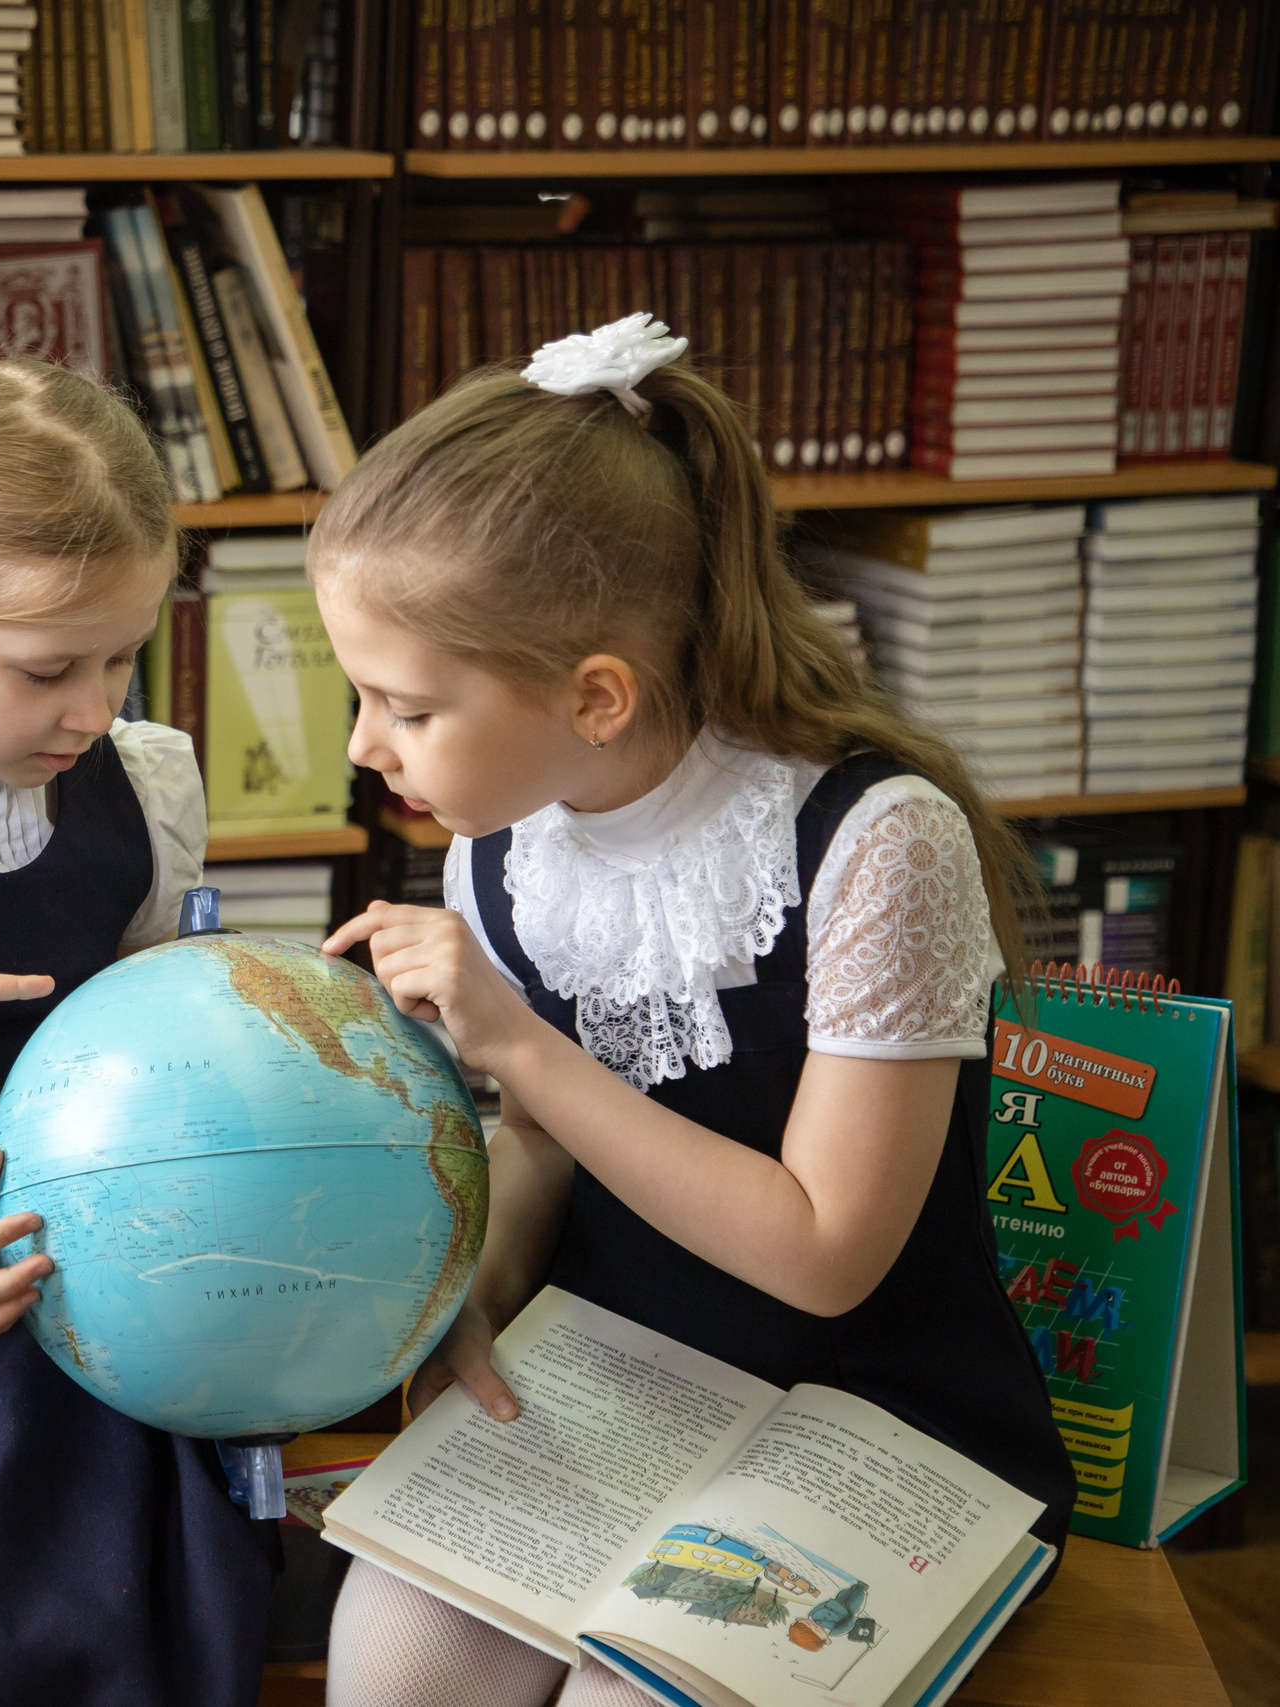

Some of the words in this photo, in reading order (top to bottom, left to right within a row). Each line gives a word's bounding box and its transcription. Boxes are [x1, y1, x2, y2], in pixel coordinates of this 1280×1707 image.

[994, 1026, 1048, 1077] 10
[1051, 1050, 1147, 1090] магнитных
[131, 1060, 210, 1077] ОКЕАН
[1046, 1065, 1085, 1089] букв
[1085, 1149, 1104, 1177] Лучшее
[1104, 1142, 1138, 1155] учебное
[1137, 1153, 1153, 1187] пособие
[1114, 1161, 1127, 1170] от
[1100, 1171, 1138, 1184] автора
[1089, 1180, 1146, 1197] «Букваря»
[205, 1285, 264, 1301] ТИХИЙ
[278, 1280, 336, 1294] ОКЕАН
[999, 1254, 1124, 1332] АЕМ
[799, 1413, 824, 1423] такой
[1068, 1409, 1083, 1418] при
[1085, 1412, 1115, 1423] письме
[795, 1431, 812, 1440] мне
[807, 1429, 846, 1449] какой-то
[814, 1438, 833, 1449] чего
[838, 1426, 875, 1447] ответили
[771, 1439, 800, 1450] совсем
[1075, 1438, 1111, 1451] навыков
[787, 1450, 824, 1467] хотелось
[802, 1448, 845, 1470] поставили
[835, 1448, 858, 1461] из-за
[783, 1463, 808, 1477] Всего
[791, 1457, 834, 1479] наверное,
[826, 1466, 842, 1477] как
[861, 1453, 894, 1475] двойку.
[861, 1460, 894, 1482] сказать,
[903, 1462, 919, 1473] что
[771, 1474, 795, 1486] было
[811, 1474, 845, 1495] двойку.
[845, 1476, 861, 1488] так,
[847, 1468, 877, 1490] двойку
[895, 1464, 931, 1488] природе.
[915, 1459, 971, 1497] учительницы:
[1083, 1471, 1108, 1482] цвета
[760, 1477, 800, 1495] началось,
[794, 1474, 837, 1498] вызывали.
[796, 1484, 812, 1494] нас
[835, 1478, 868, 1501] двойки,
[895, 1481, 929, 1505] смешно
[896, 1473, 945, 1506] несчастную
[920, 1472, 967, 1505] Интересно,
[803, 1494, 817, 1504] это
[827, 1498, 847, 1512] утра.
[839, 1497, 861, 1512] меня
[846, 1492, 882, 1517] получил
[878, 1487, 905, 1506] пятую
[942, 1493, 963, 1509] воды
[974, 1497, 990, 1509] рос
[820, 1504, 836, 1516] всё
[869, 1498, 901, 1523] Четыре
[879, 1496, 911, 1519] отвечал
[907, 1506, 921, 1517] вот
[930, 1504, 953, 1522] Даже
[947, 1505, 960, 1516] эту
[965, 1508, 980, 1520] рот
[379, 1513, 425, 1538] испаряется
[838, 1514, 862, 1531] когда
[848, 1511, 877, 1532] самого
[863, 1512, 895, 1535] каждом
[913, 1499, 966, 1537] справедливо.
[913, 1518, 928, 1529] что
[893, 1522, 932, 1549] предмету
[902, 1521, 926, 1537] день!
[932, 1530, 943, 1540] то,
[936, 1523, 960, 1542] телям.
[425, 1535, 459, 1554] которая
[866, 1532, 888, 1547] день,
[887, 1536, 910, 1553] везло
[460, 1553, 482, 1566] вода,
[891, 1547, 905, 1559] тот
[925, 1552, 942, 1565] ков.
[908, 1554, 931, 1575] В
[483, 1564, 518, 1583] девается
[519, 1581, 542, 1596] Куда
